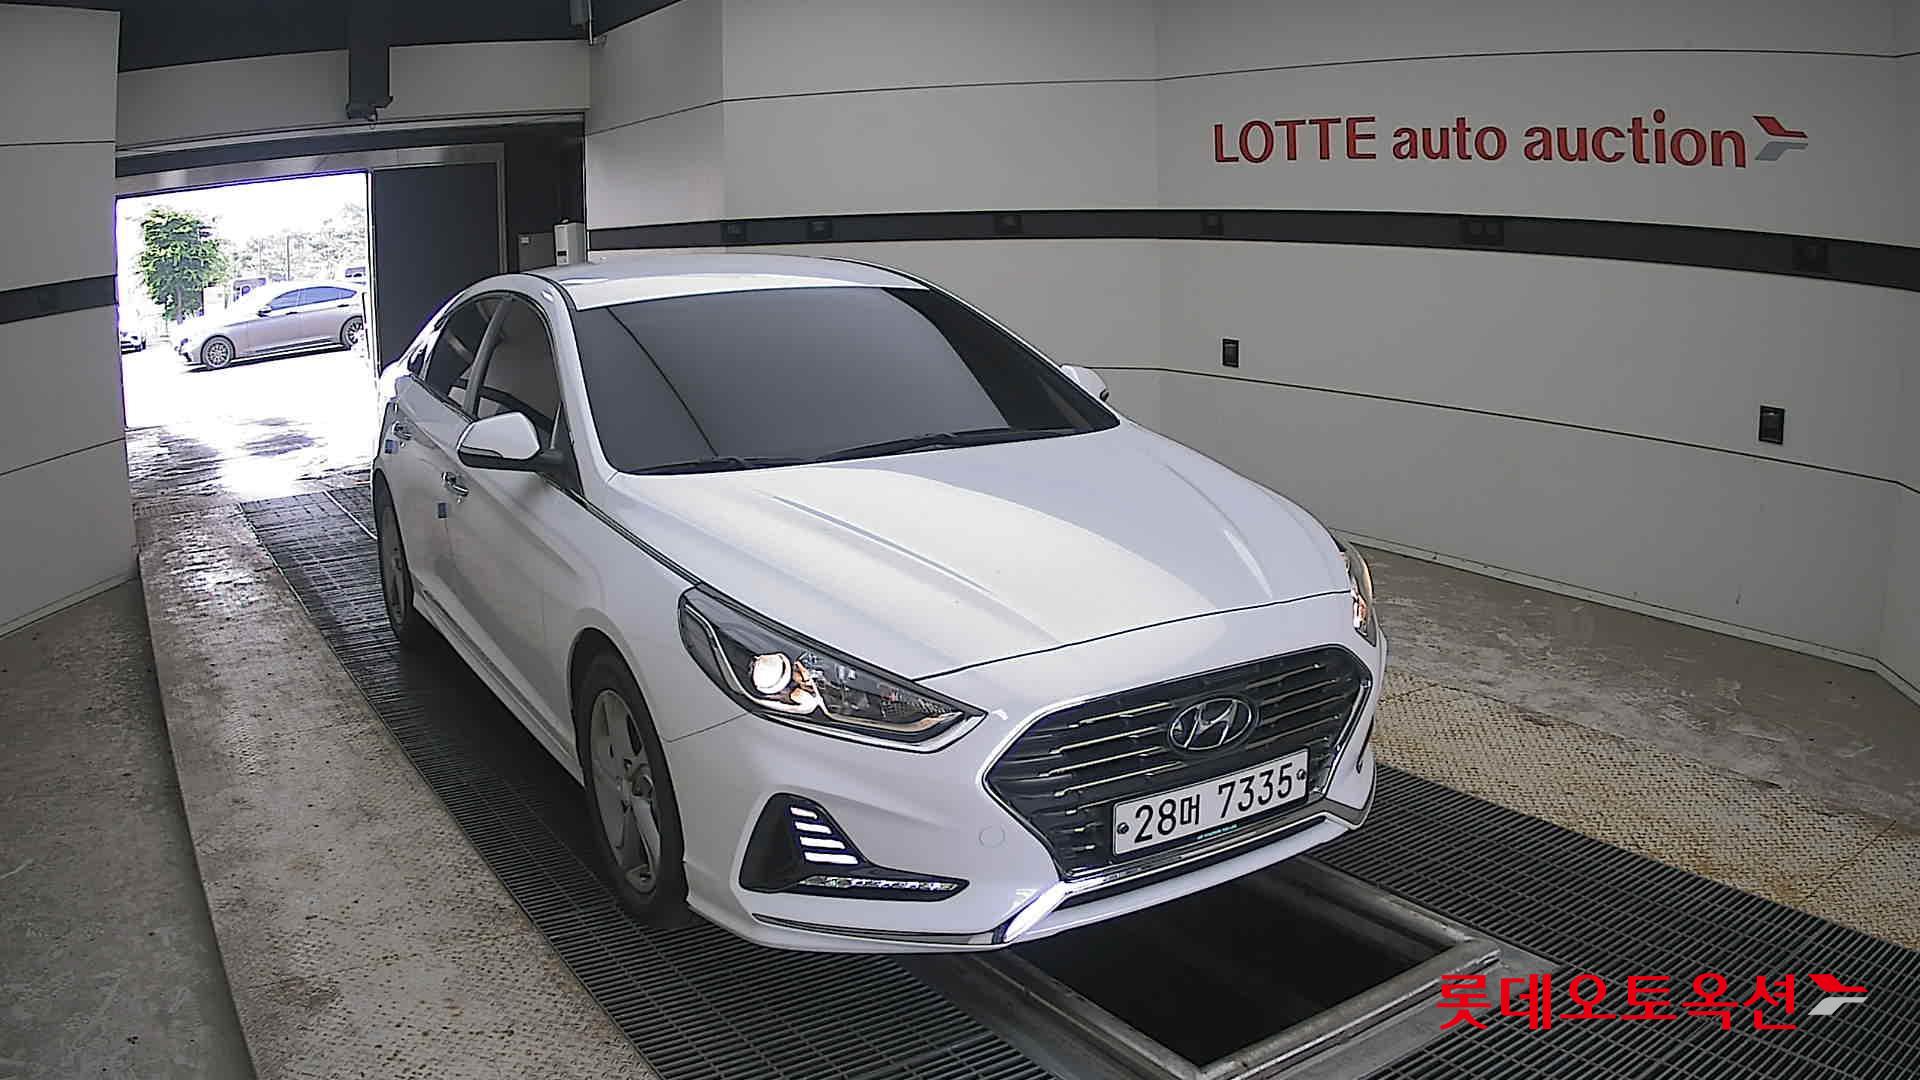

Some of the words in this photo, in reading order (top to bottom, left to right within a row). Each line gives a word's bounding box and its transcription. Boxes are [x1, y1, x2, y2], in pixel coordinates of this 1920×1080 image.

[1213, 116, 1377, 164] LOTTE
[1392, 117, 1508, 161] auto
[1523, 109, 1747, 168] auction
[1134, 794, 1201, 843] 28머
[1217, 762, 1293, 818] 7335
